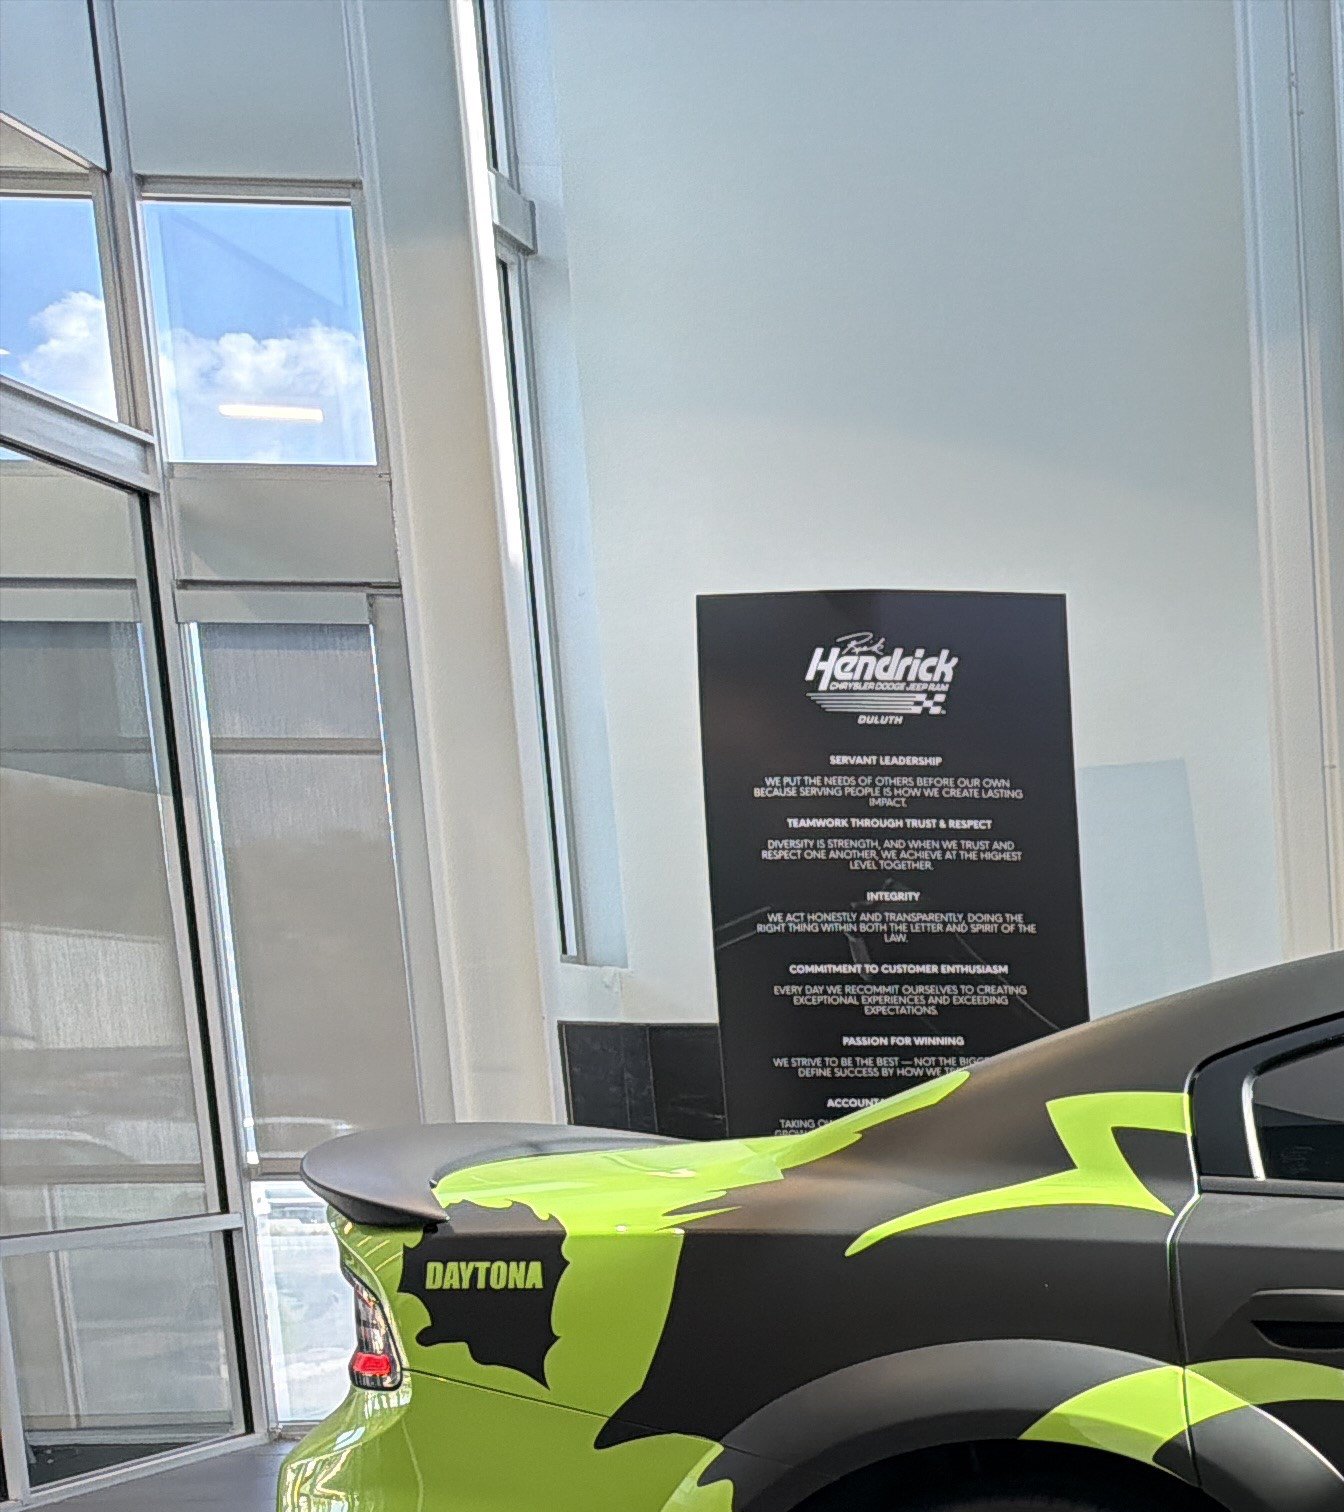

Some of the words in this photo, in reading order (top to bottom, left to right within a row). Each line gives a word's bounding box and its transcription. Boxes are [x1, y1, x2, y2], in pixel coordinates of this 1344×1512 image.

[804, 646, 959, 692] Hendrick
[829, 682, 876, 691] CHRYSLER
[875, 682, 906, 691] DODGE
[906, 683, 928, 691] JEEP
[928, 684, 950, 692] RAM
[857, 715, 904, 725] DULUTH
[830, 755, 876, 765] SERVANT
[880, 756, 942, 766] LEADERSHIP
[782, 777, 800, 787] PUT
[803, 777, 821, 787] THE
[824, 777, 855, 787] NEEDS
[875, 777, 913, 787] OTHERS
[916, 778, 954, 787] BEFORE
[957, 778, 979, 787] OUR
[982, 778, 1009, 787] OWN
[754, 787, 796, 797] BECAUSE
[799, 787, 841, 797] SERVING
[844, 788, 880, 798] PEOPLE
[894, 788, 920, 798] HOW
[942, 788, 979, 798] CREATE
[982, 789, 1023, 798] LASTING
[787, 818, 847, 828] TEAMWORK
[851, 818, 902, 829] THROUGH
[905, 819, 936, 829] TRUST
[948, 819, 992, 829] RESPECT
[767, 840, 814, 849] DIVERSITY
[883, 840, 905, 850] AND
[907, 840, 939, 850] WHEN
[960, 840, 989, 850] TRUST
[992, 840, 1014, 850] AND
[762, 850, 801, 860] RESPECT
[804, 850, 826, 860] ONE
[899, 850, 942, 860] ACHIEVE
[959, 851, 977, 860] THE
[980, 851, 1021, 860] HIGHEST
[849, 860, 877, 870] LEVEL
[866, 892, 920, 901] INTEGRITY
[785, 913, 804, 922] ACT
[807, 913, 856, 922] HONESTLY
[859, 913, 881, 922] AND
[967, 913, 1002, 922] DOING
[1005, 913, 1023, 922] THE
[757, 923, 785, 933] RIGHT
[788, 923, 818, 933] THING
[821, 923, 857, 933] WITHIN
[859, 923, 887, 933] BOTH
[889, 923, 907, 933] THE
[910, 923, 943, 933] LETTER
[946, 924, 967, 933] AND
[970, 924, 998, 933] SPIRIT
[1018, 924, 1036, 933] THE
[789, 964, 861, 974] COMMITMENT
[881, 964, 937, 974] CUSTOMER
[941, 964, 1008, 974] ENTHUSIASM
[773, 986, 802, 995] EVERY
[805, 986, 823, 995] DAY
[845, 985, 899, 995] RECOMMIT
[902, 985, 957, 995] OURSELVES
[976, 985, 1027, 995] CREATING
[793, 996, 858, 1006] EXCEPTIONAL
[861, 996, 925, 1005] EXPERIENCES
[928, 995, 949, 1005] AND
[952, 995, 1009, 1005] EXCEEDING
[843, 1036, 887, 1046] PASSION
[891, 1036, 910, 1046] FOR
[914, 1036, 964, 1046] WINNING
[791, 1057, 821, 1067] STRIVE
[855, 1057, 873, 1067] THE
[876, 1057, 899, 1067] BEST
[914, 1057, 935, 1067] NOT
[938, 1057, 956, 1067] THE
[798, 1068, 831, 1077] DEFINE
[834, 1067, 879, 1077] SUCCESS
[897, 1067, 923, 1077] HOW
[780, 1119, 814, 1129] TAKING
[425, 1260, 545, 1291] DAYTONA
